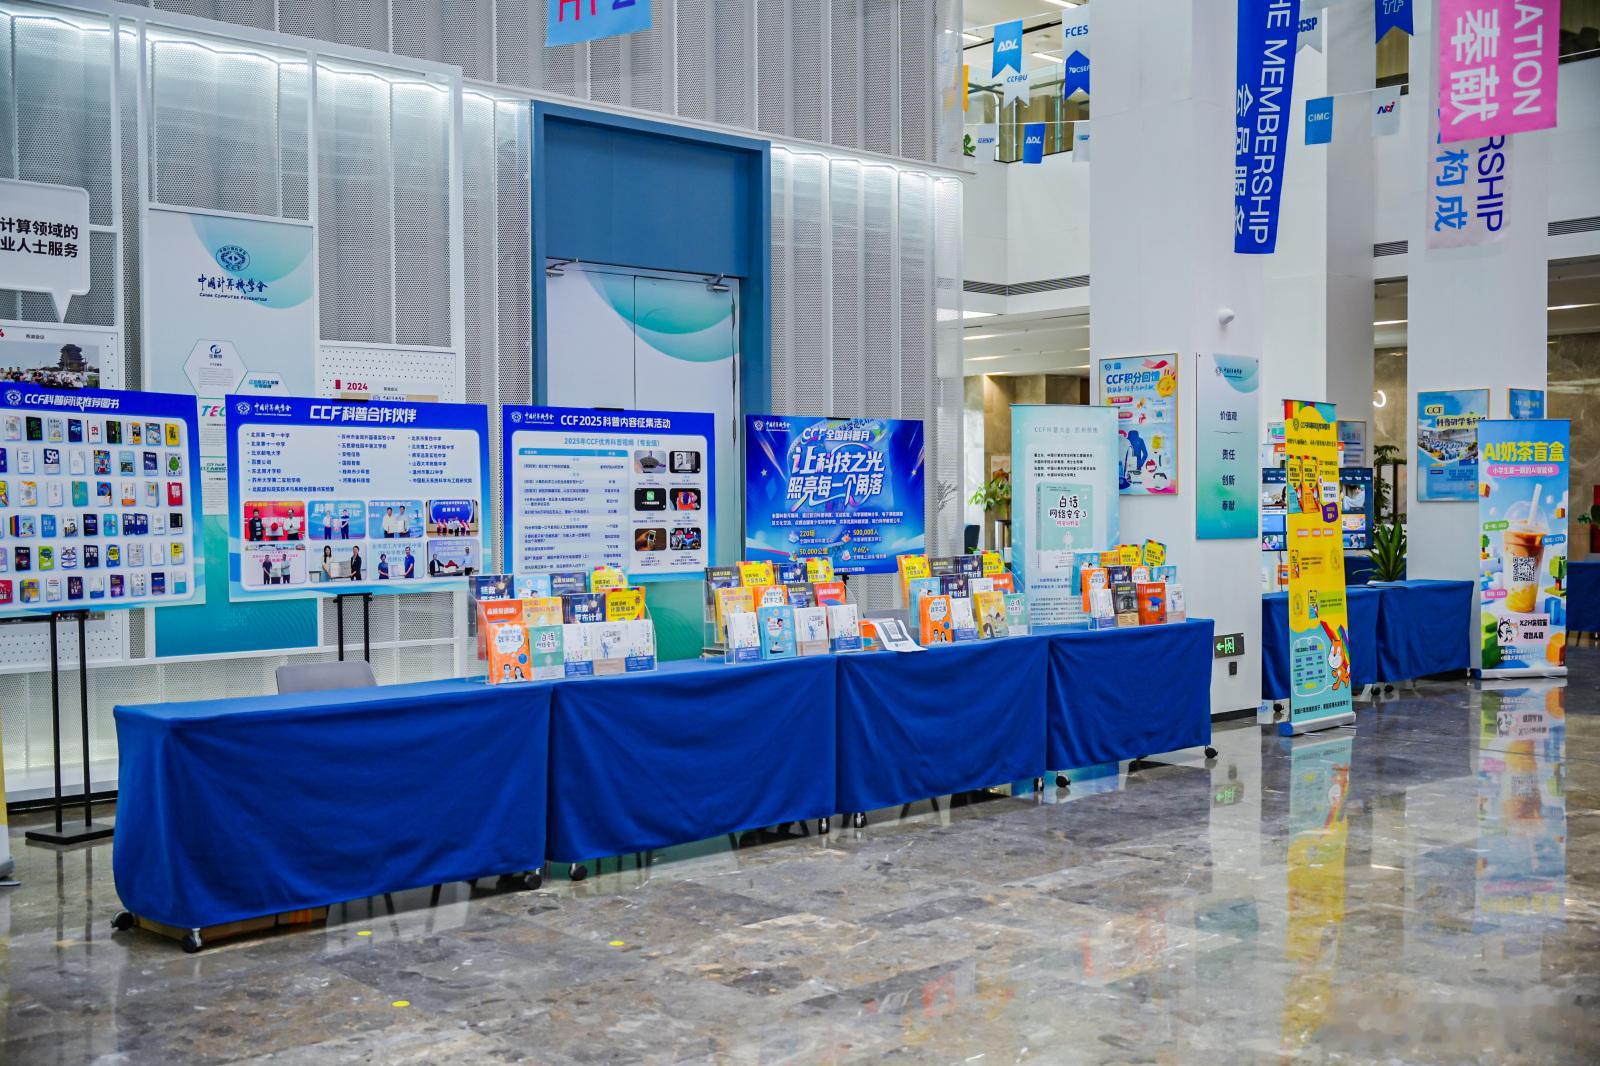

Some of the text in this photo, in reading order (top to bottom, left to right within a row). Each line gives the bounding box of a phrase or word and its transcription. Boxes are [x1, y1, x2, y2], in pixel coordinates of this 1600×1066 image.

[1065, 25, 1089, 38] FCES
[1298, 17, 1318, 32] CSP
[1450, 8, 1500, 125] 奉献
[1513, 0, 1543, 116] ATION
[1307, 112, 1330, 122] CIMC
[1248, 39, 1288, 244] MEMBERSHIP
[0, 217, 79, 240] 计算领域的
[0, 236, 79, 258] 业人士服务
[347, 382, 369, 391] 2024
[309, 404, 417, 424] CCF科普合作伙伴
[802, 428, 870, 441] CCF全国科普月
[791, 445, 885, 474] 让科技之光
[1483, 441, 1565, 462] AI奶茶盲盒
[787, 474, 882, 506] 照亮每一个角落
